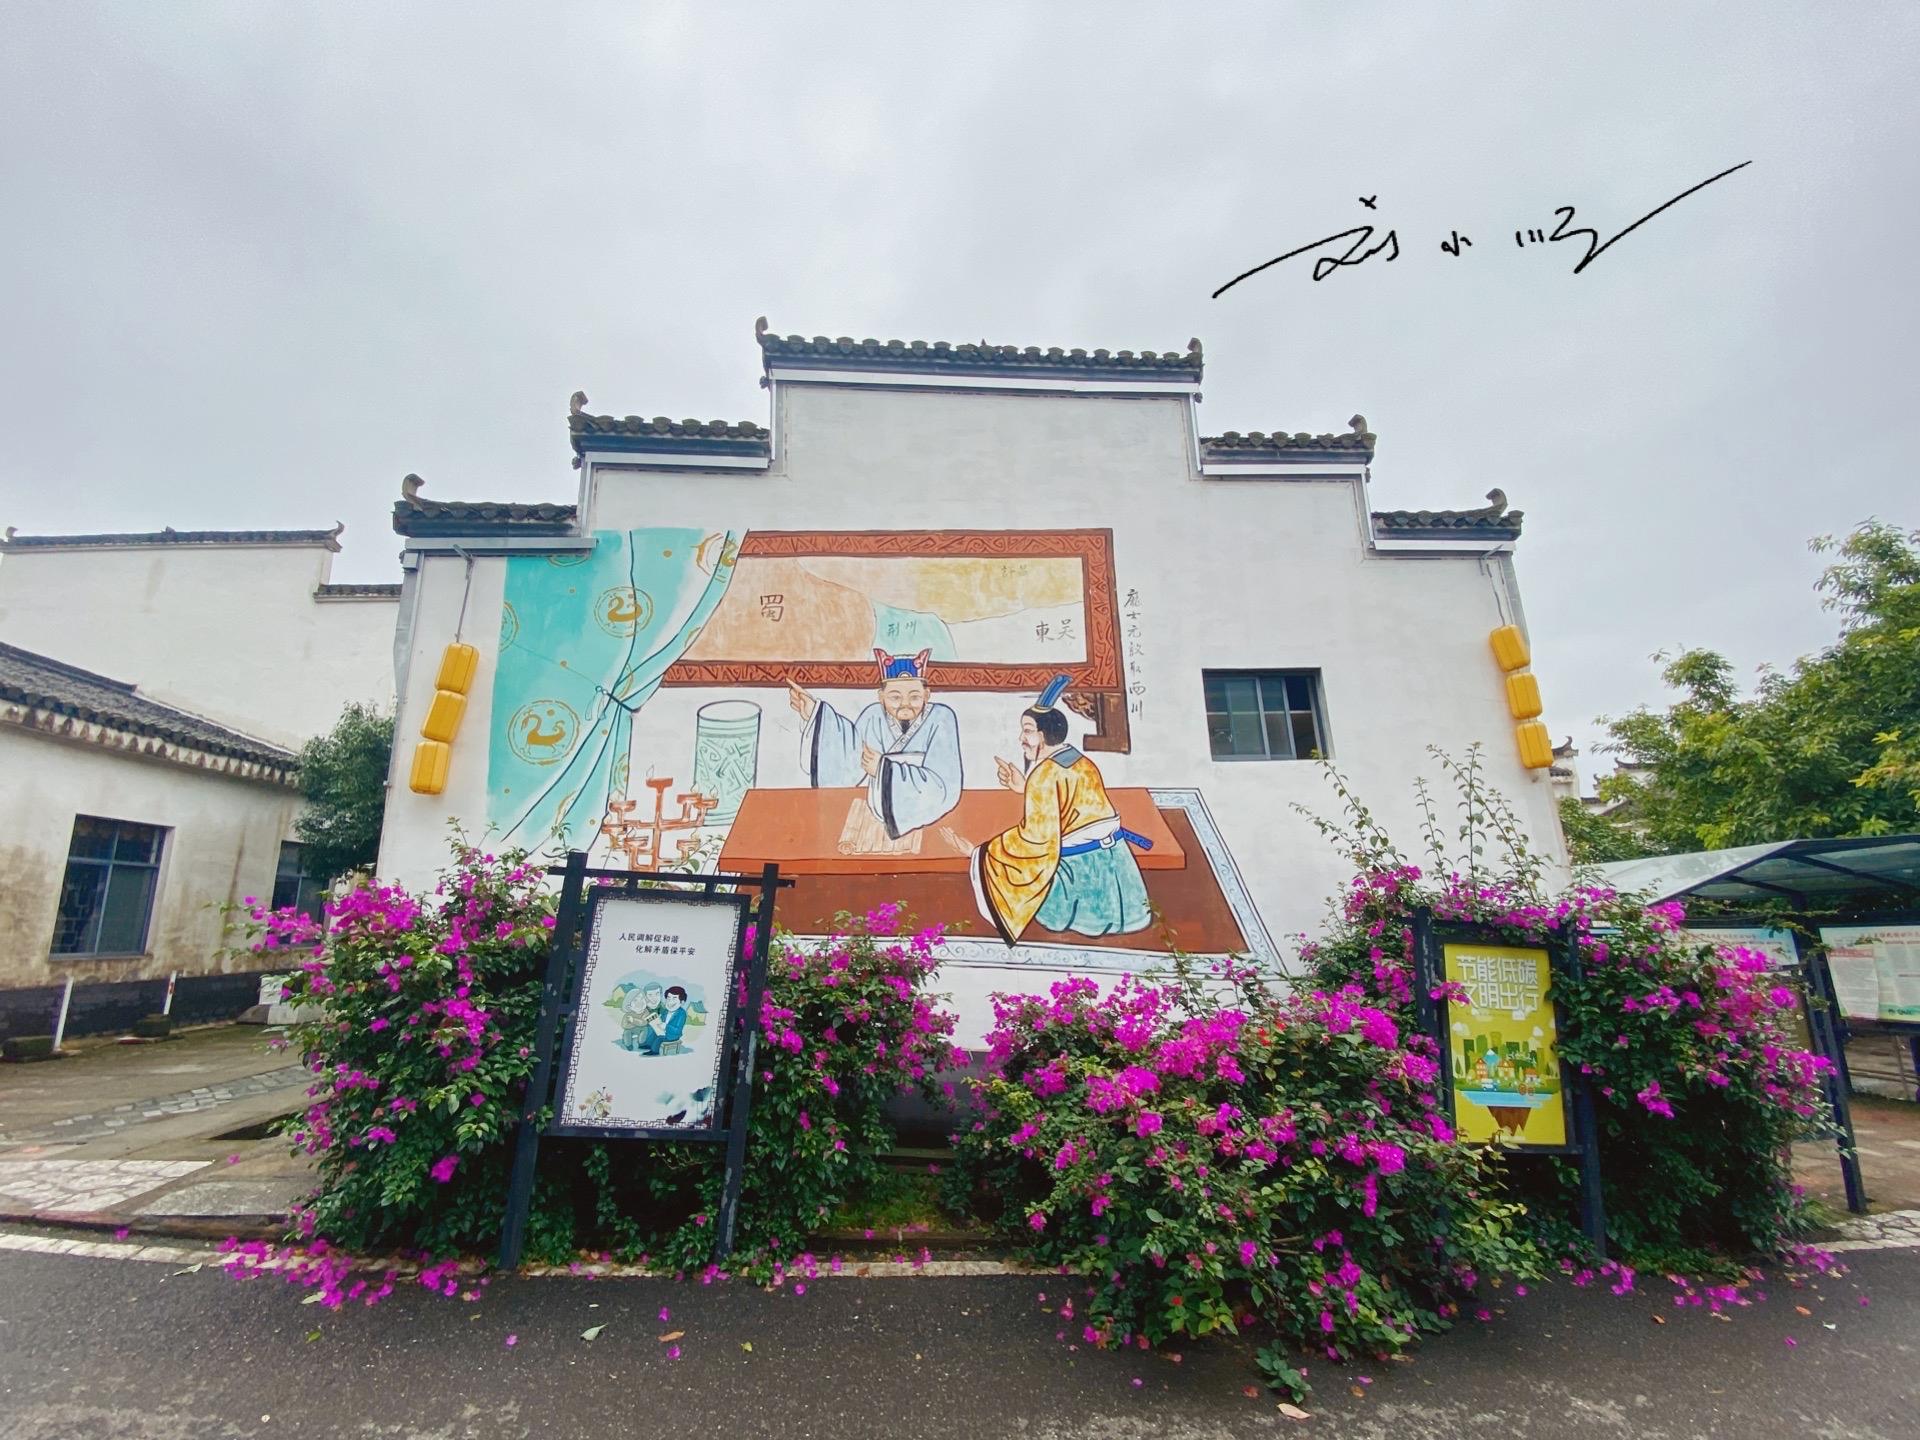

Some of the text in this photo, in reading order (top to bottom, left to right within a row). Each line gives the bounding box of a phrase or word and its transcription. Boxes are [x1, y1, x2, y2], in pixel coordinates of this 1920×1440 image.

[619, 932, 679, 943] 人民调解促和谐
[636, 945, 696, 955] 化解矛盾保平安
[1456, 955, 1538, 985] 节能低碳
